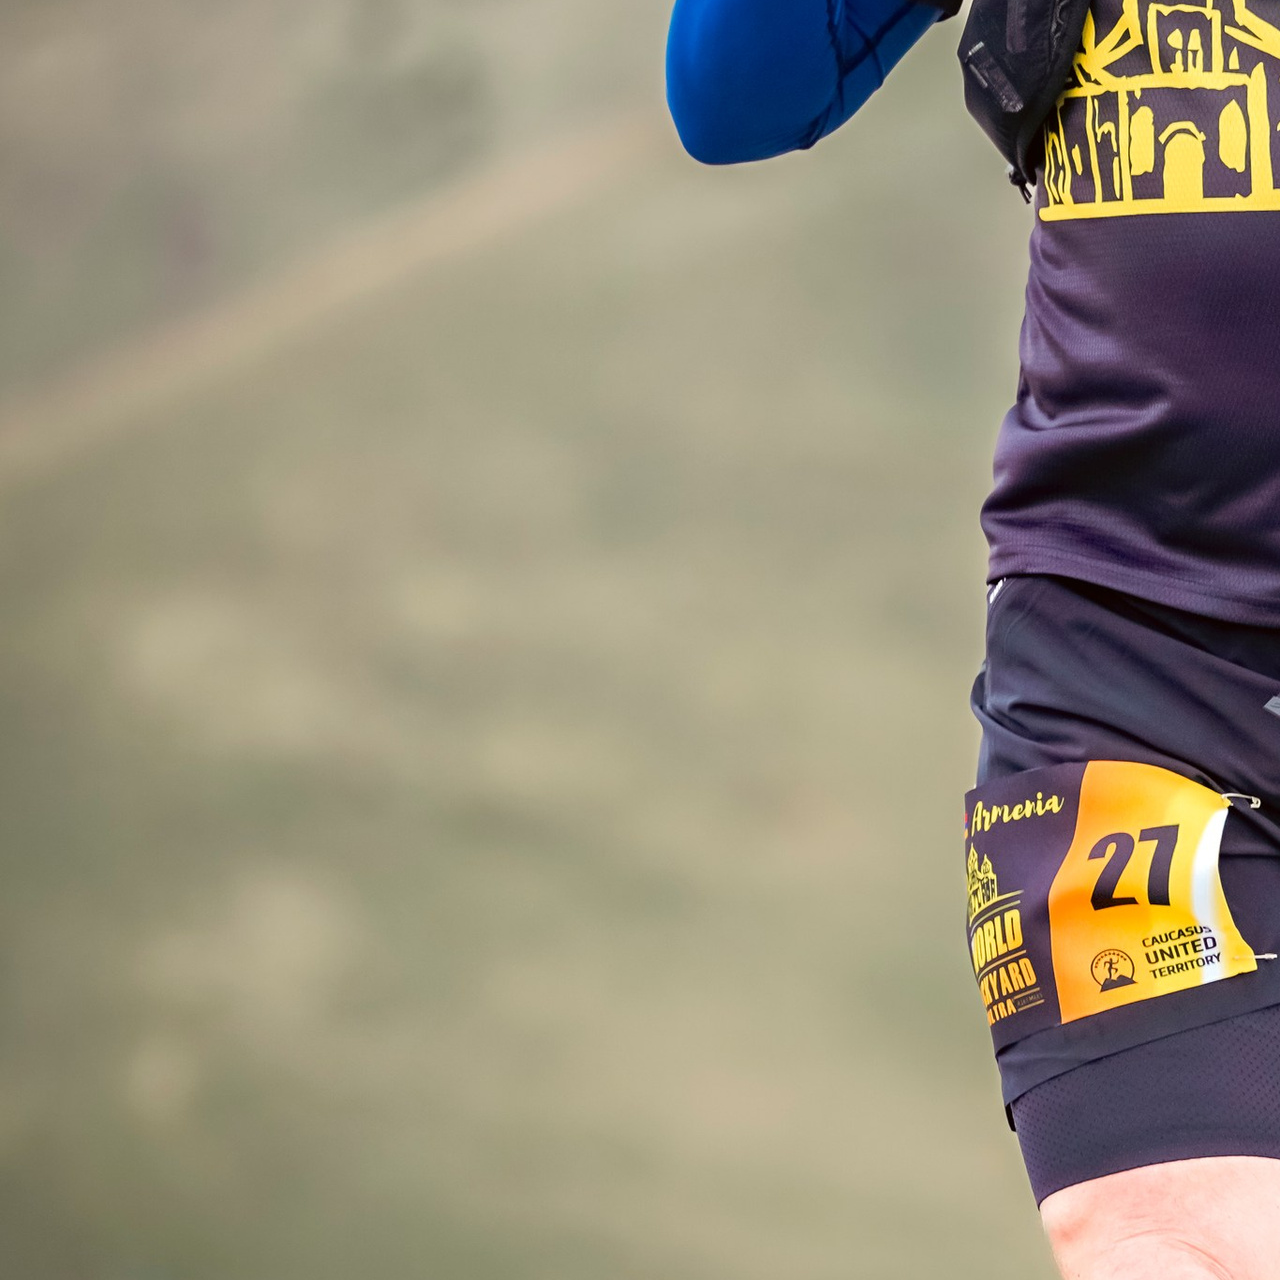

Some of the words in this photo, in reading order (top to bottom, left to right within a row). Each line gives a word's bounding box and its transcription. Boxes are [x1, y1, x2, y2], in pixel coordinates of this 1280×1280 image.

[971, 792, 1064, 837] Armenia
[1087, 824, 1180, 911] 27
[1142, 925, 1212, 948] CAUCASUS
[1145, 936, 1217, 964] UNITED
[1150, 952, 1221, 979] TERRITORY
